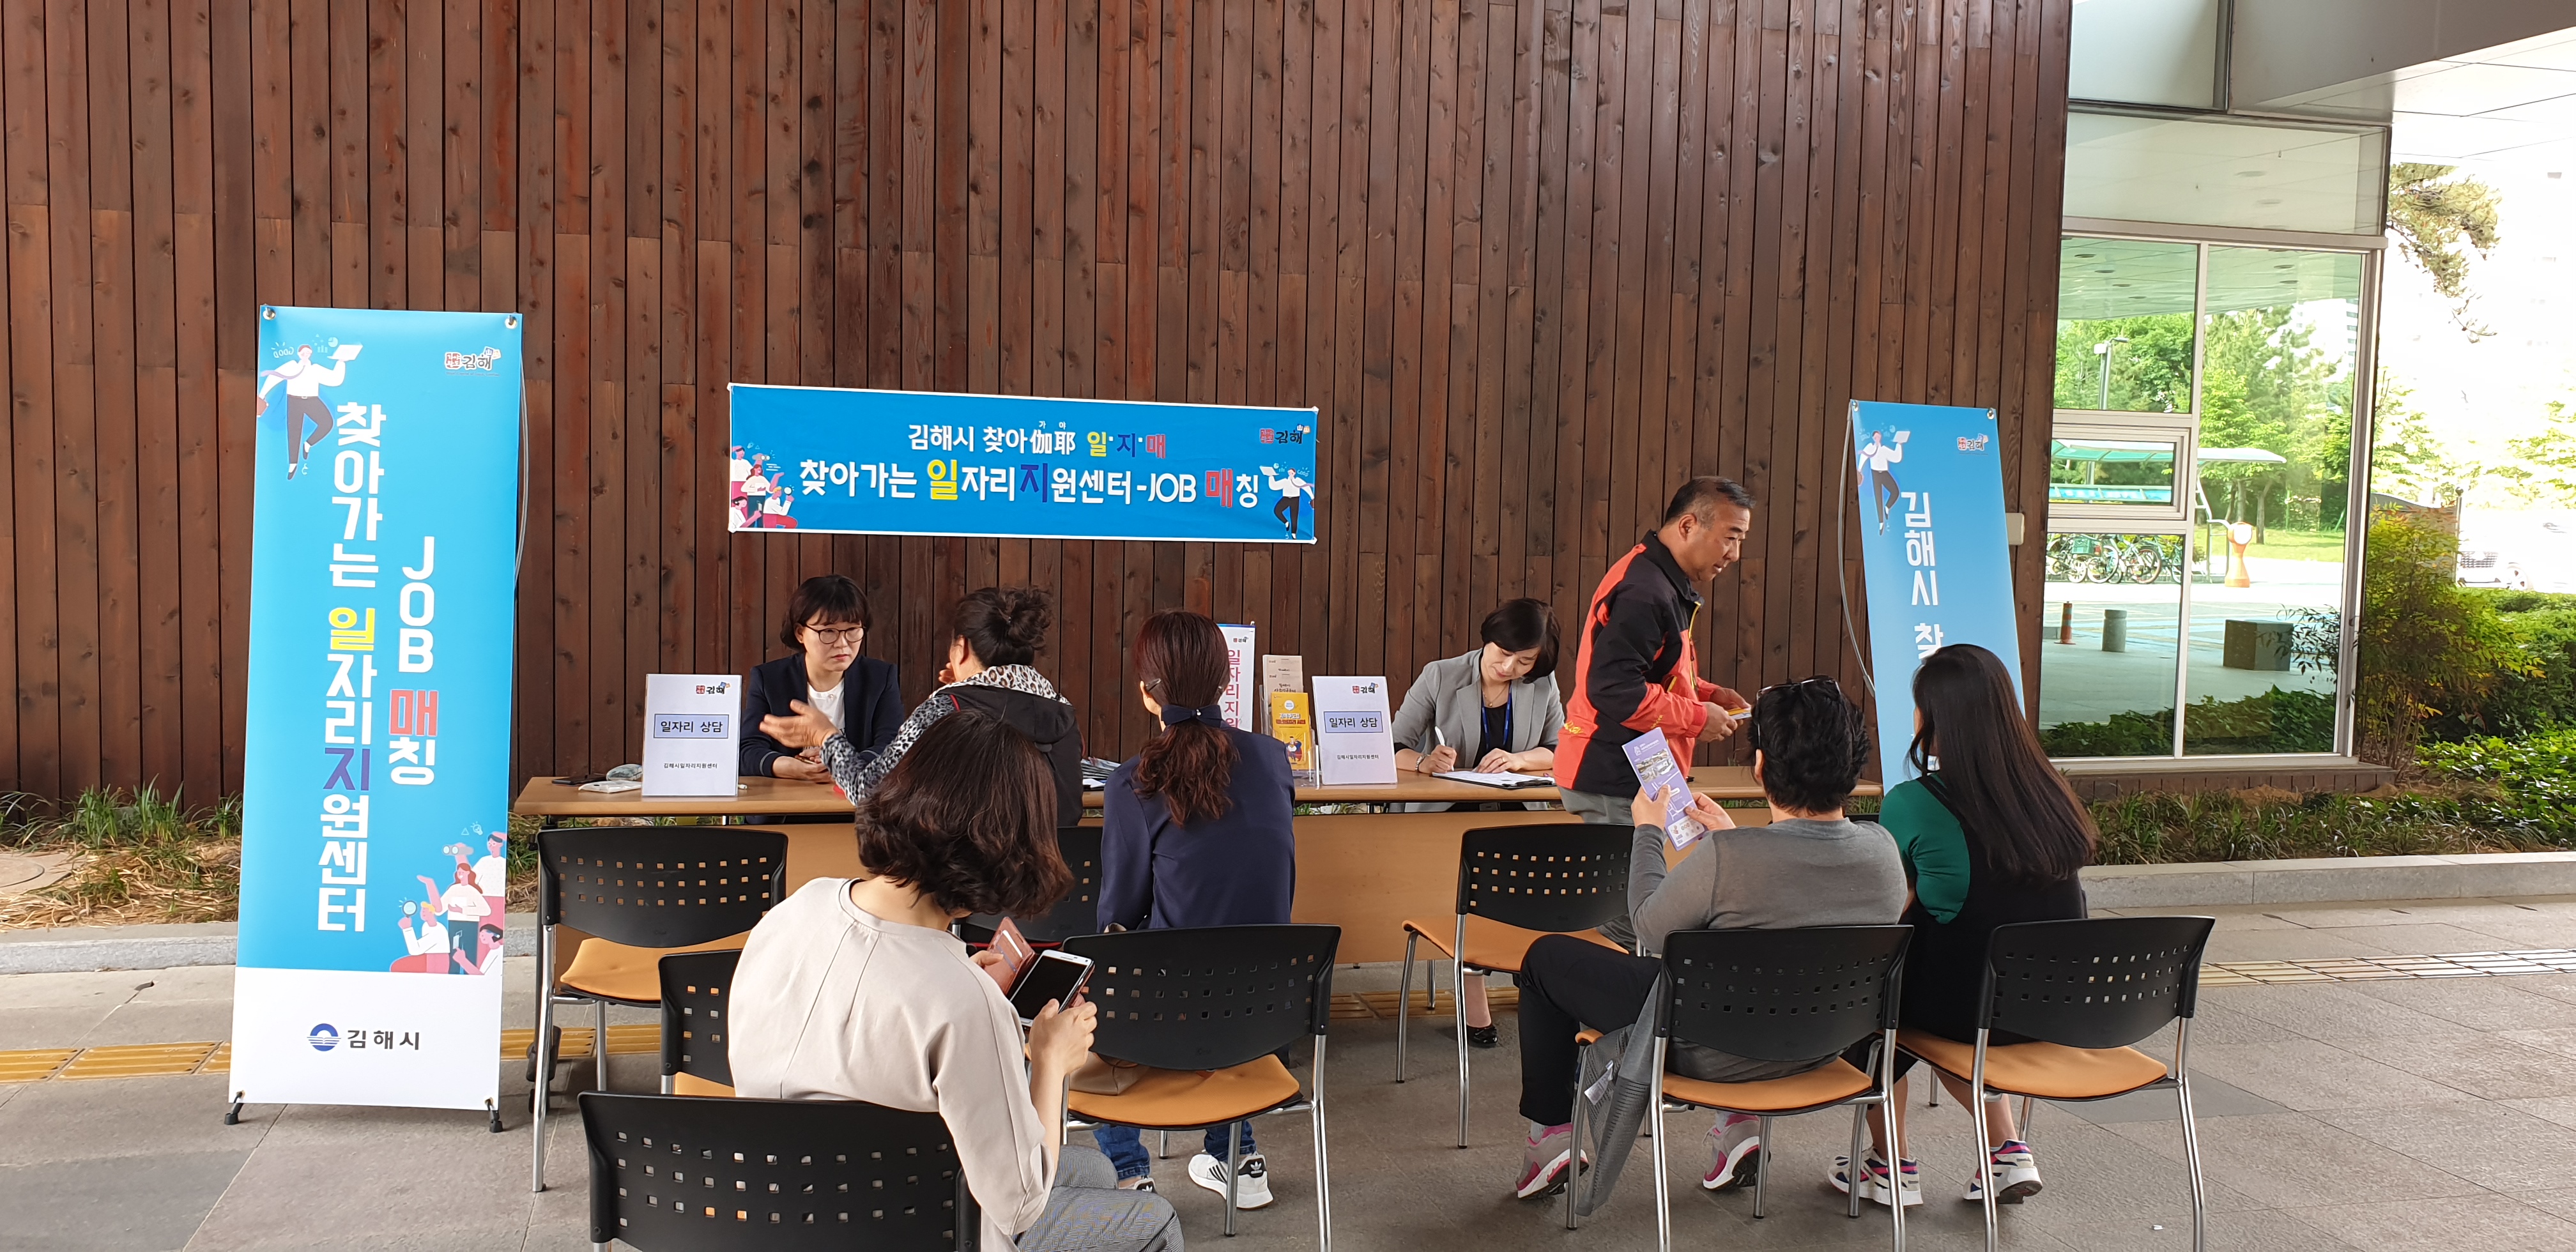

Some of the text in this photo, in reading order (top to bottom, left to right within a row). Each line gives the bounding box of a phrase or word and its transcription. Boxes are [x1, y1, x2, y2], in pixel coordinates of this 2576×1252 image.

[462, 354, 491, 369] 김해
[908, 424, 974, 452] 김해시
[983, 426, 1077, 455] 찾아伽耶
[1275, 429, 1303, 445] 김해
[1966, 439, 1984, 450] 김해
[799, 459, 917, 499] 찾아가는
[1204, 468, 1259, 508] 매칭
[1901, 491, 1939, 607] 김해시
[318, 401, 387, 933] 찾아가는 일자리지원센터
[388, 535, 439, 786] JOB 매칭
[706, 685, 725, 694] 김해
[1360, 685, 1376, 694] 김해
[661, 721, 723, 733] 일자리 상담
[1329, 717, 1378, 728] 일자리 상담
[347, 1029, 420, 1051] 김해시
